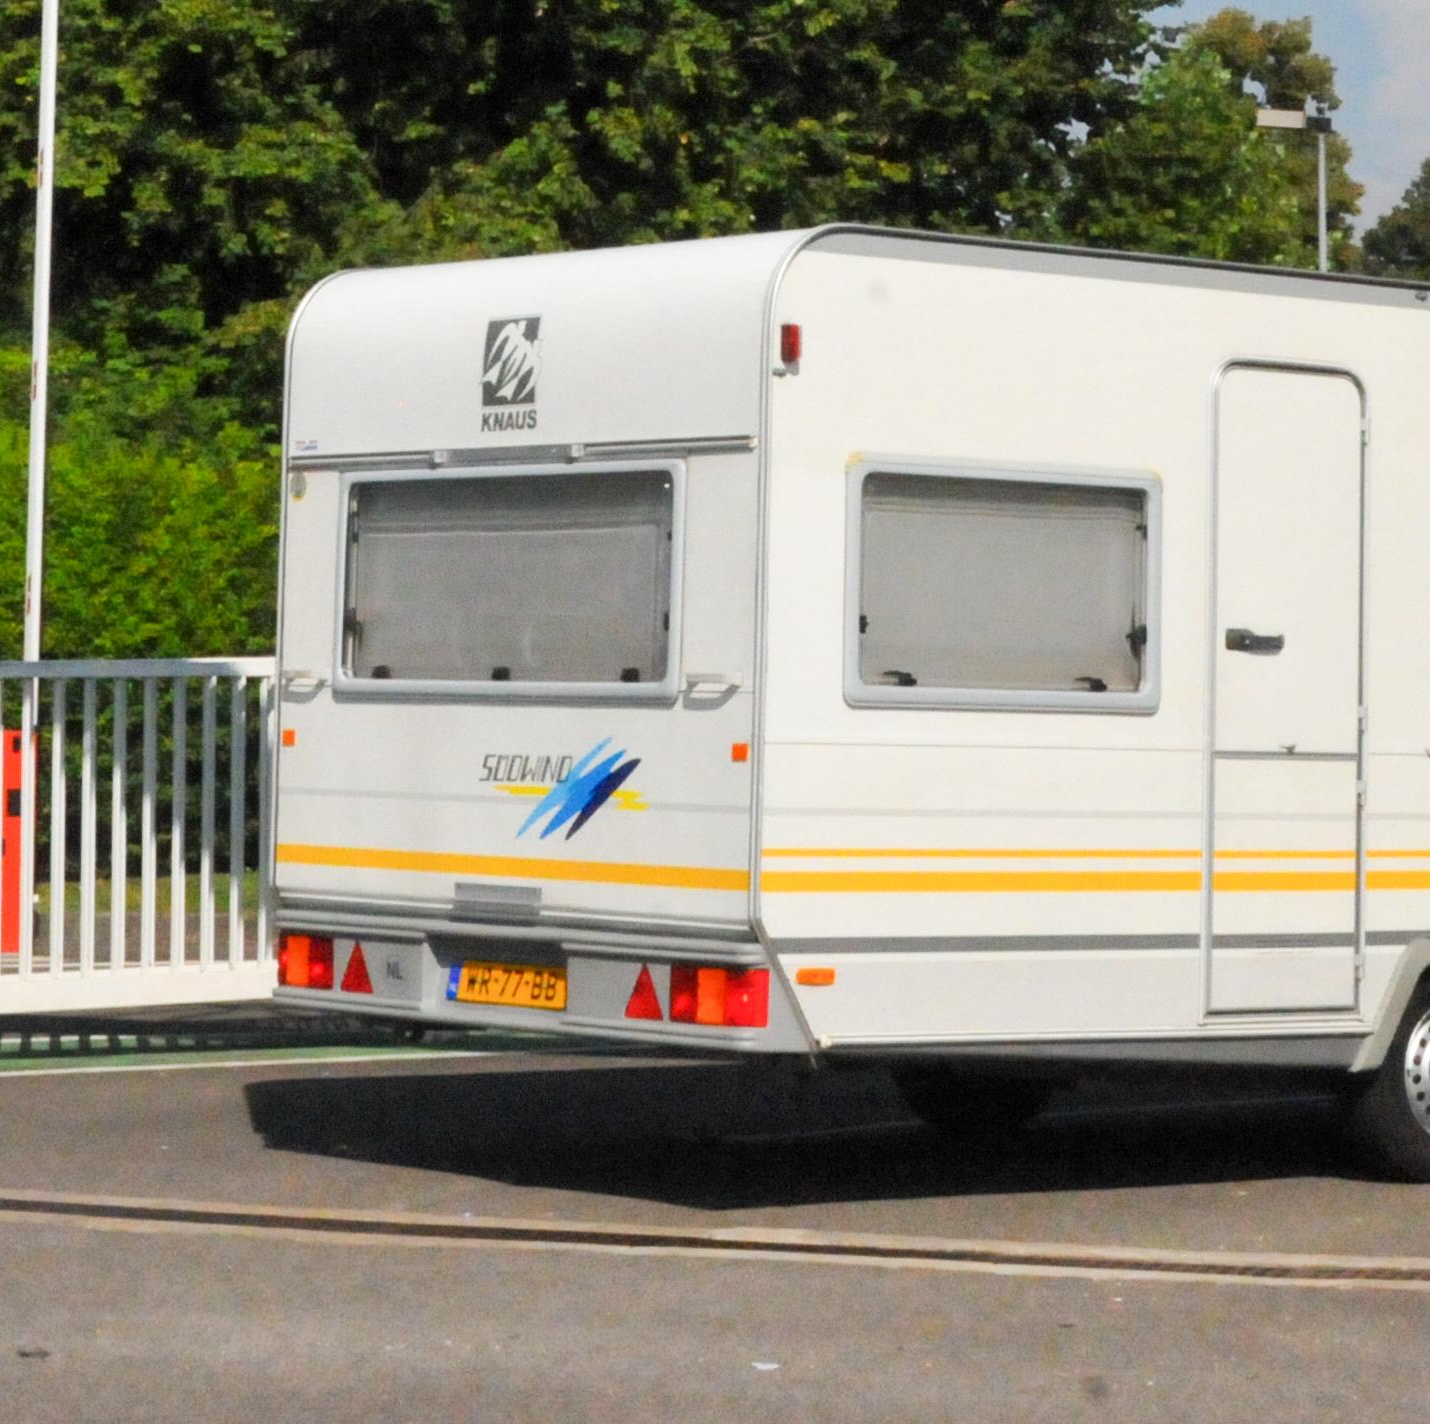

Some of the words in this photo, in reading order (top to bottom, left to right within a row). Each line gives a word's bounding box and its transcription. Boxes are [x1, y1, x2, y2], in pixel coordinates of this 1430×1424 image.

[481, 409, 537, 432] KNAUS
[386, 961, 402, 980] NL
[467, 967, 559, 1001] WR-77-BB
